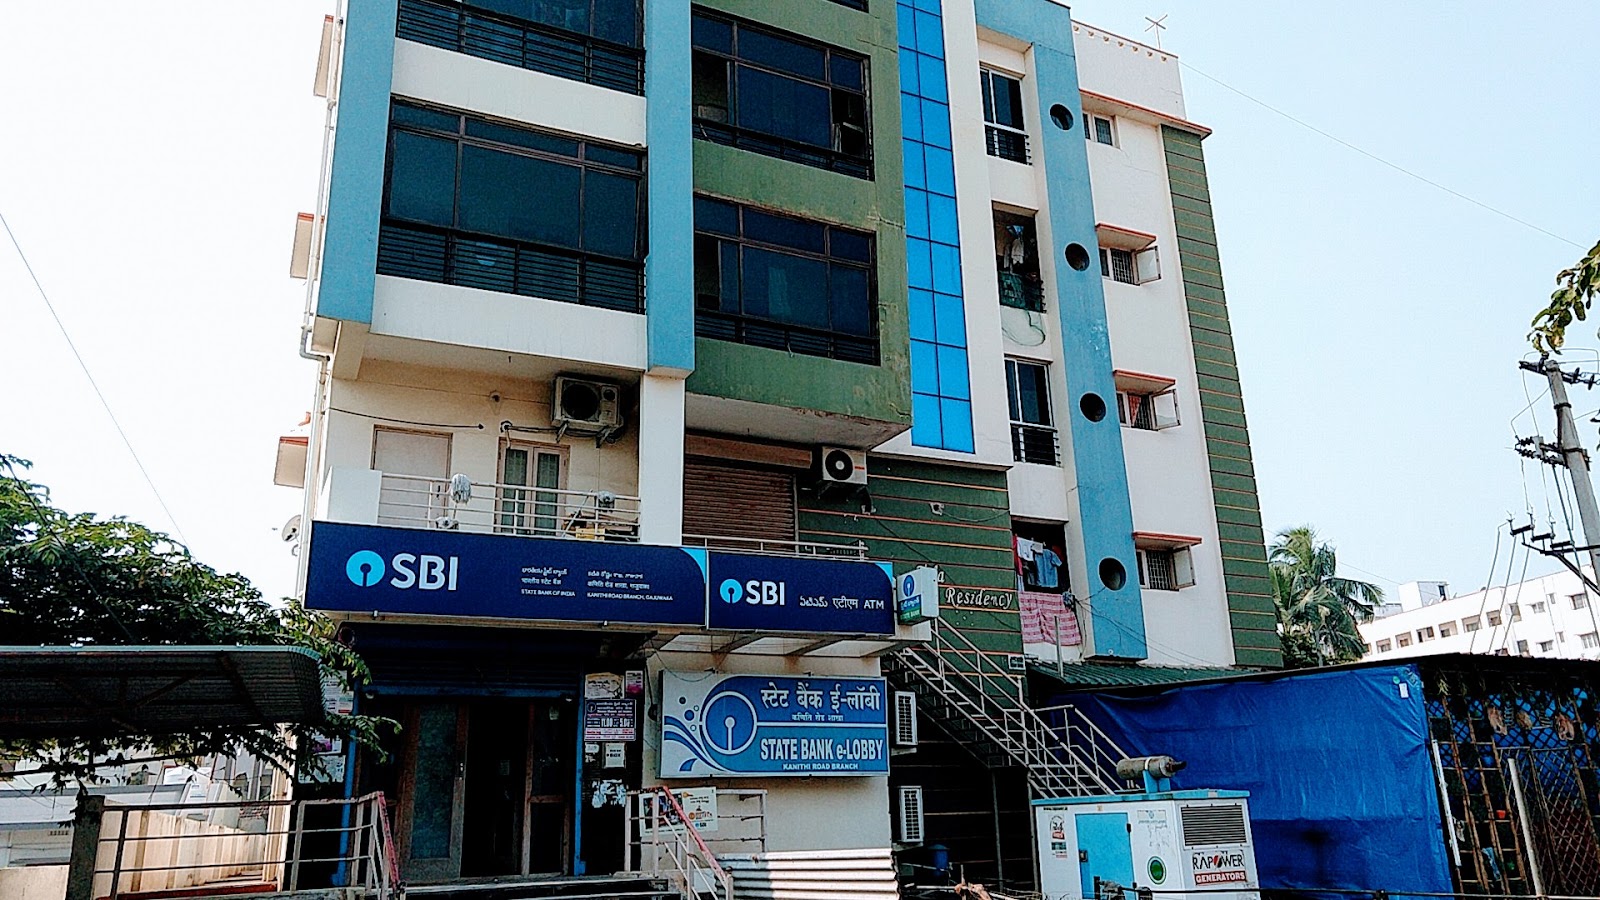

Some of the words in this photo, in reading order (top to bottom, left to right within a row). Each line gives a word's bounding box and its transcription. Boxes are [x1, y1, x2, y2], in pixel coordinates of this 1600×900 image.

[390, 552, 459, 591] SBI
[746, 580, 785, 606] SBI
[832, 595, 859, 610] एटीएम
[863, 599, 885, 610] ATM
[945, 587, 1013, 610] Residency
[760, 681, 789, 709] स्टेट
[796, 682, 823, 709] बैंक
[829, 683, 881, 713] ई-लॉबी
[760, 738, 798, 760] STATE
[801, 738, 834, 760] BANK
[836, 738, 884, 760] e-LOBBY
[1195, 872, 1246, 883] GENERATORS
